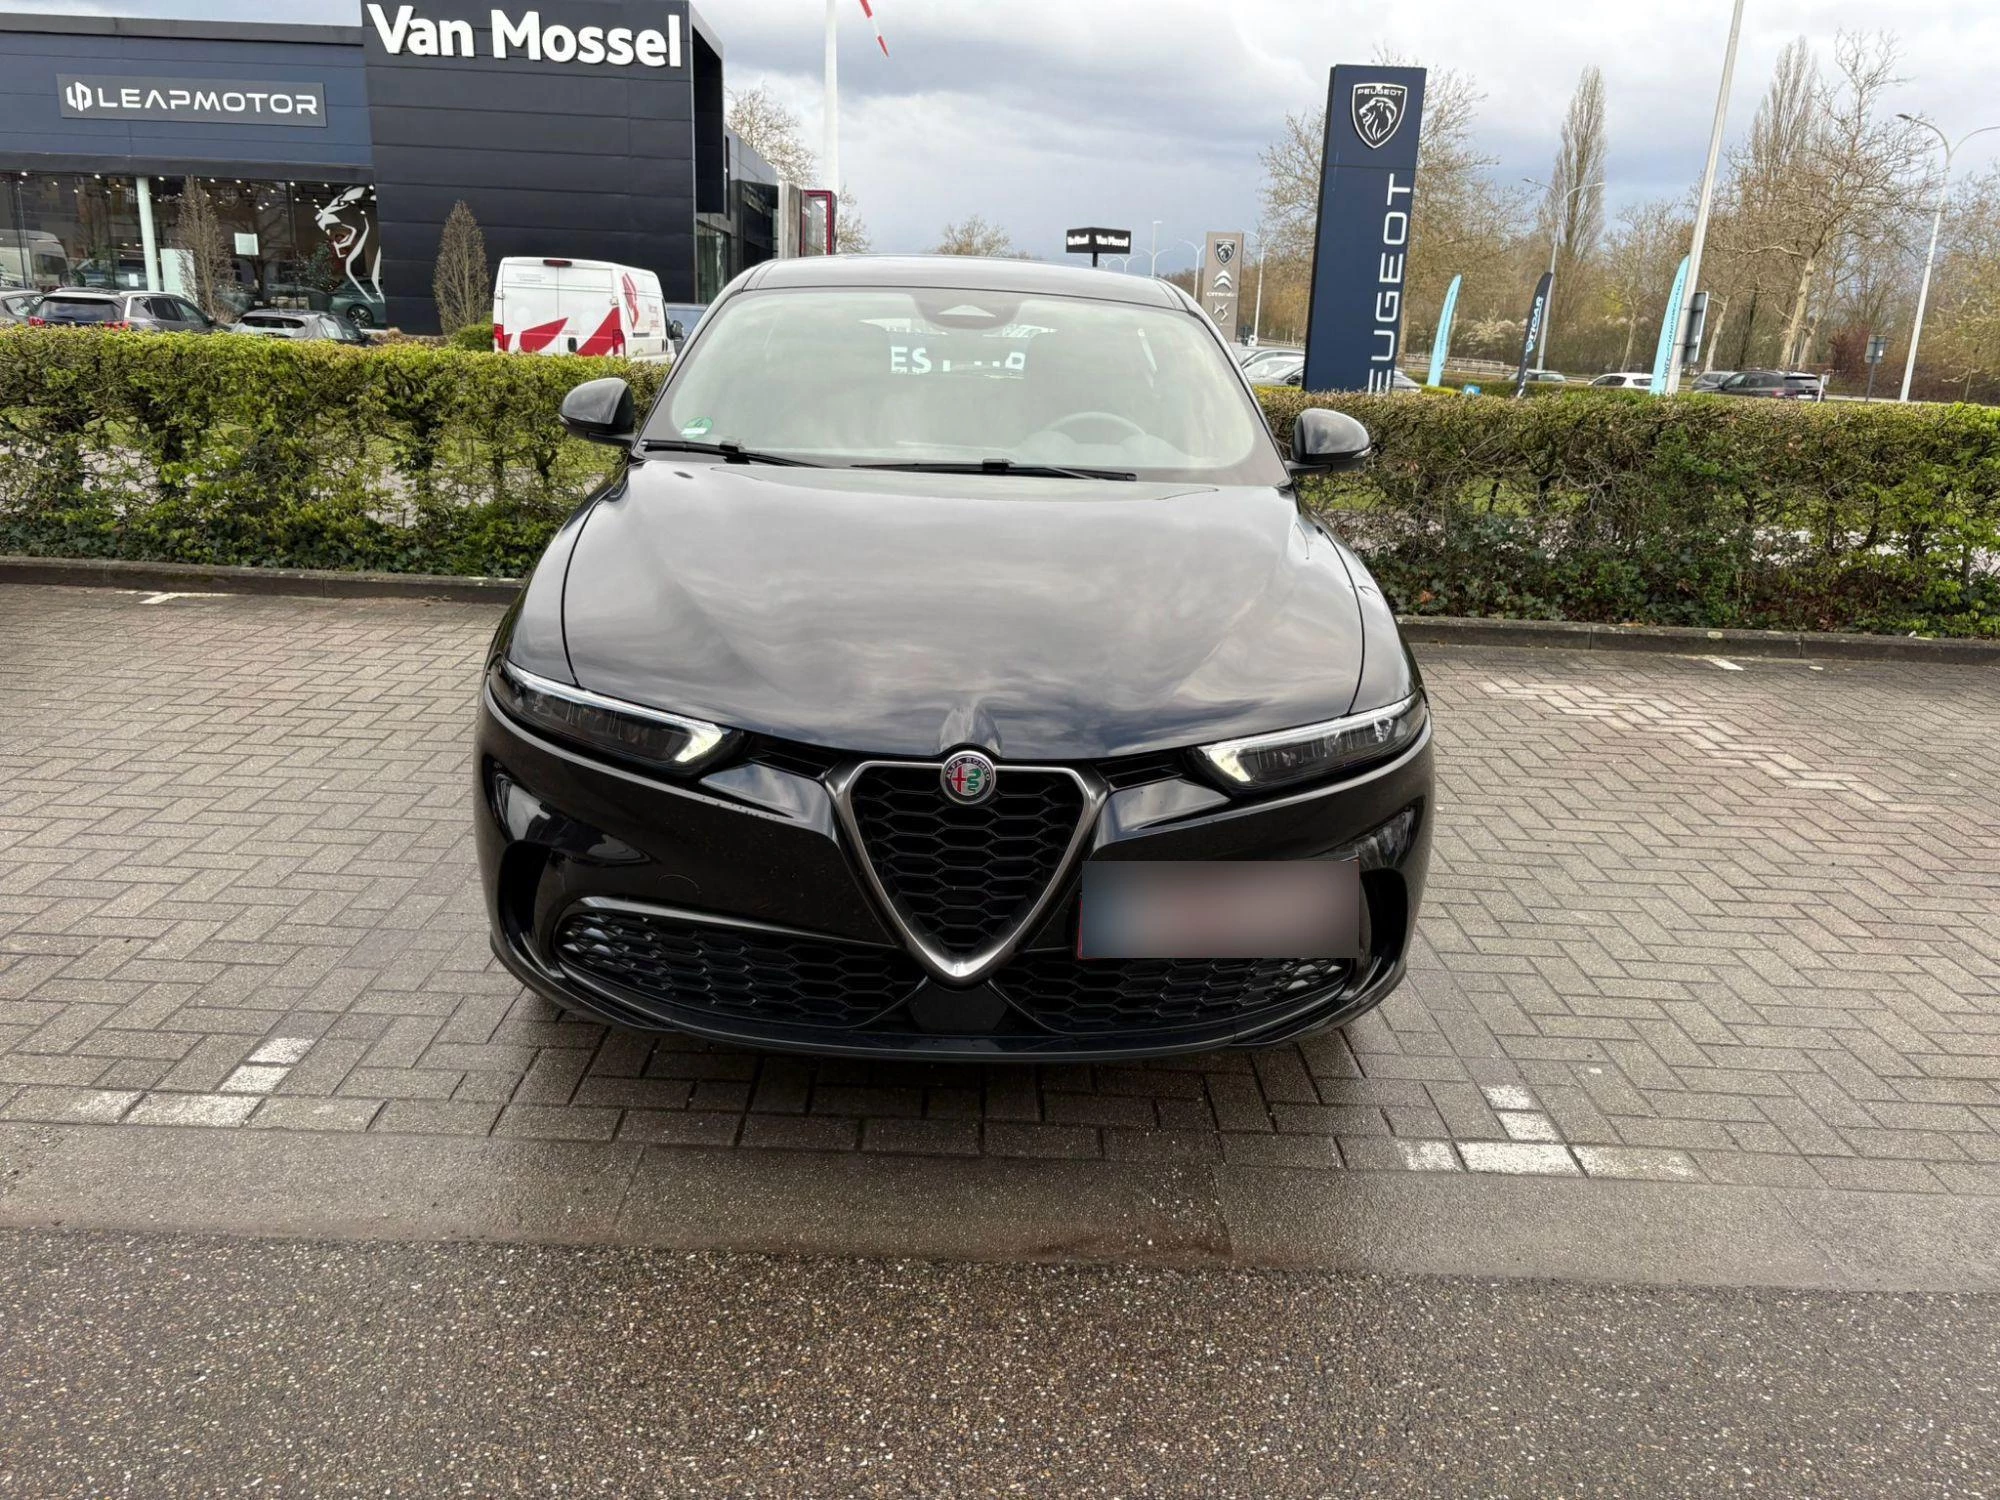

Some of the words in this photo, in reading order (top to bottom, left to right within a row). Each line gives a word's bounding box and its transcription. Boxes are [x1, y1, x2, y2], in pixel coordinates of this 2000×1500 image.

[366, 3, 475, 57] Van
[490, 9, 682, 67] Mossel
[98, 88, 318, 115] LEAPMOTOR
[1357, 88, 1403, 97] PEUGEOT
[1368, 173, 1411, 395] EUGEOT
[946, 761, 962, 779] ALFA
[966, 757, 990, 780] ROMEO
